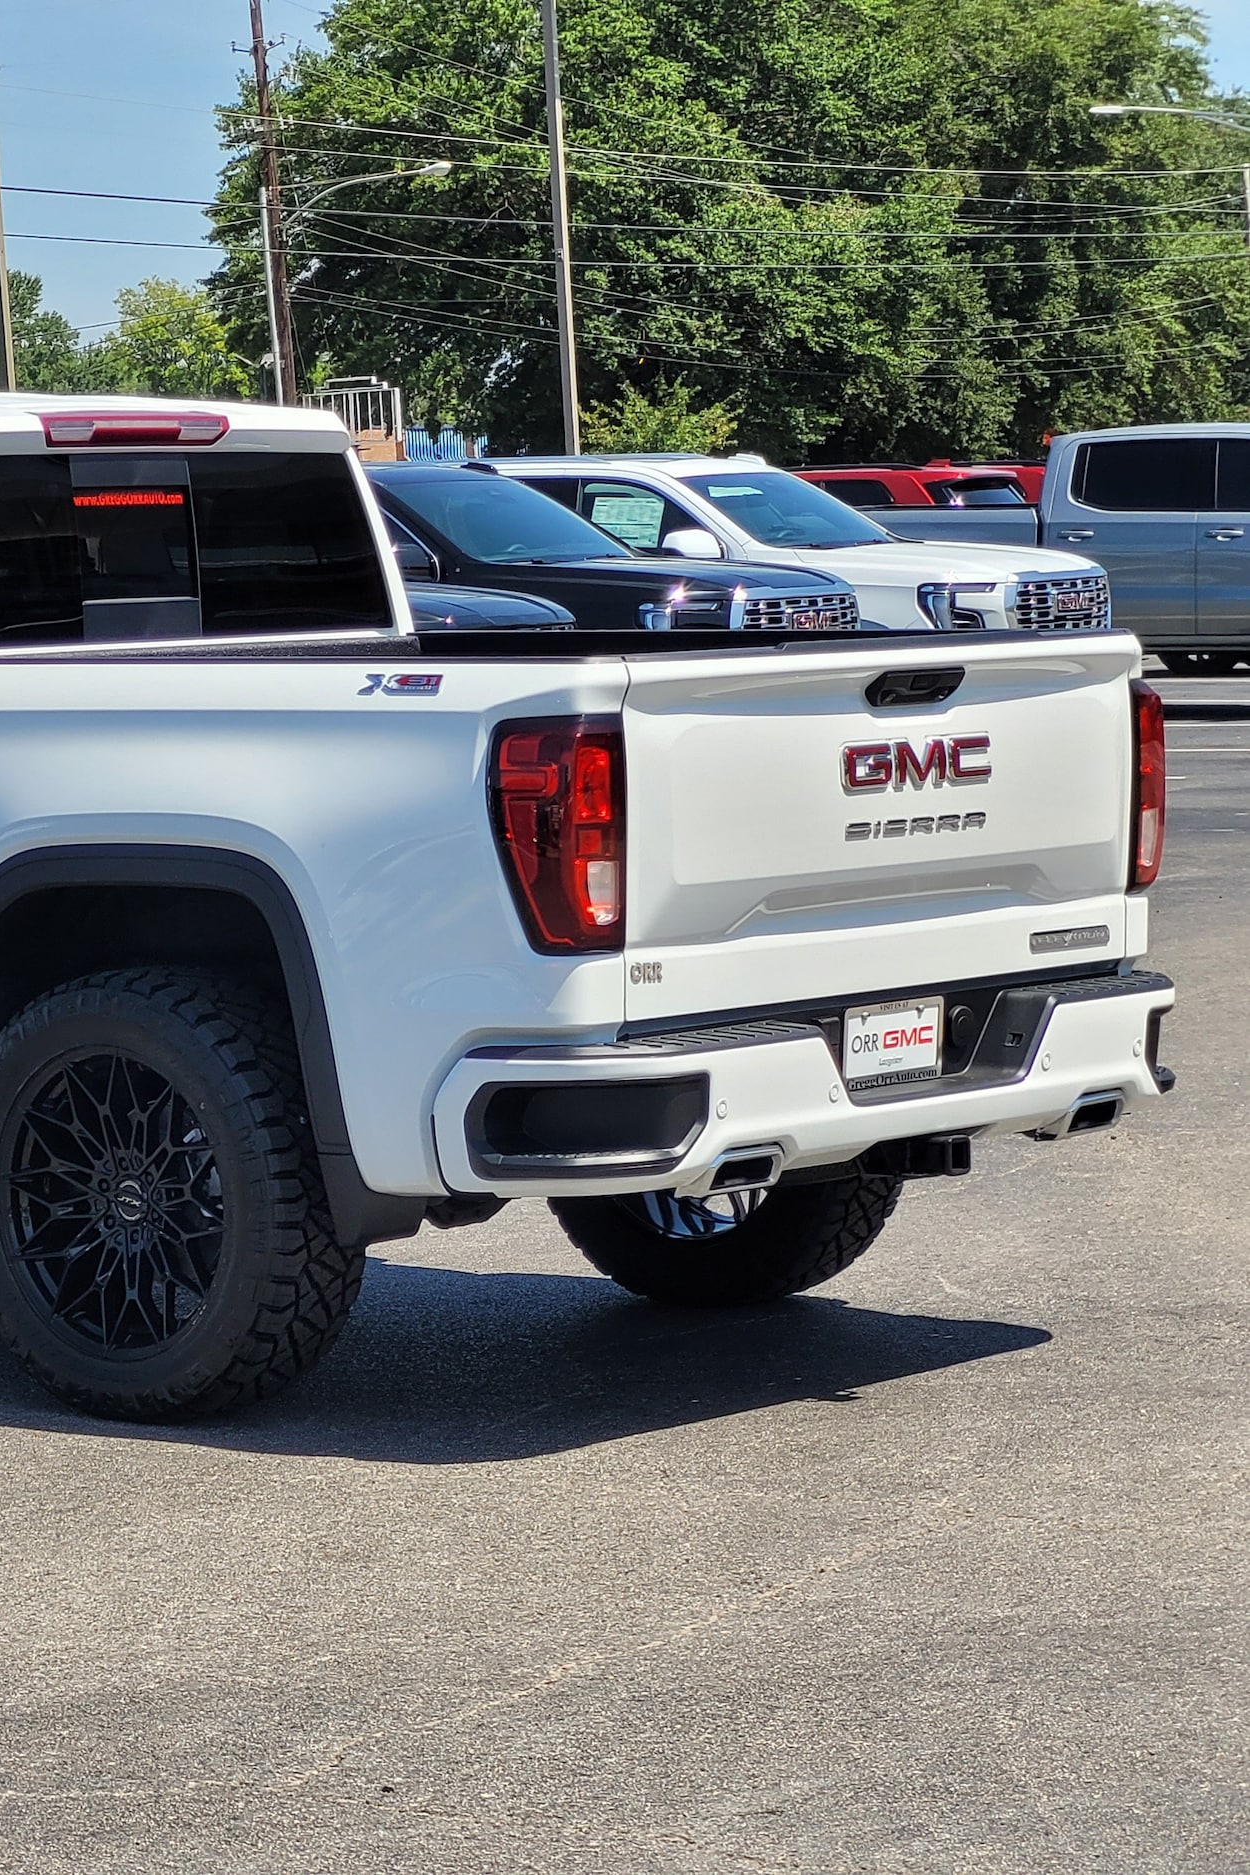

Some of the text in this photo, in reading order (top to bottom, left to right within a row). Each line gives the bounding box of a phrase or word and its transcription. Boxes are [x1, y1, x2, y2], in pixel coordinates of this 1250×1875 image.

[840, 732, 992, 796] GMC
[845, 812, 986, 841] SIERRA
[630, 961, 662, 984] ORR
[852, 1025, 933, 1053] ORR GMC
[847, 1069, 938, 1091] GreggOrrAuto.com
